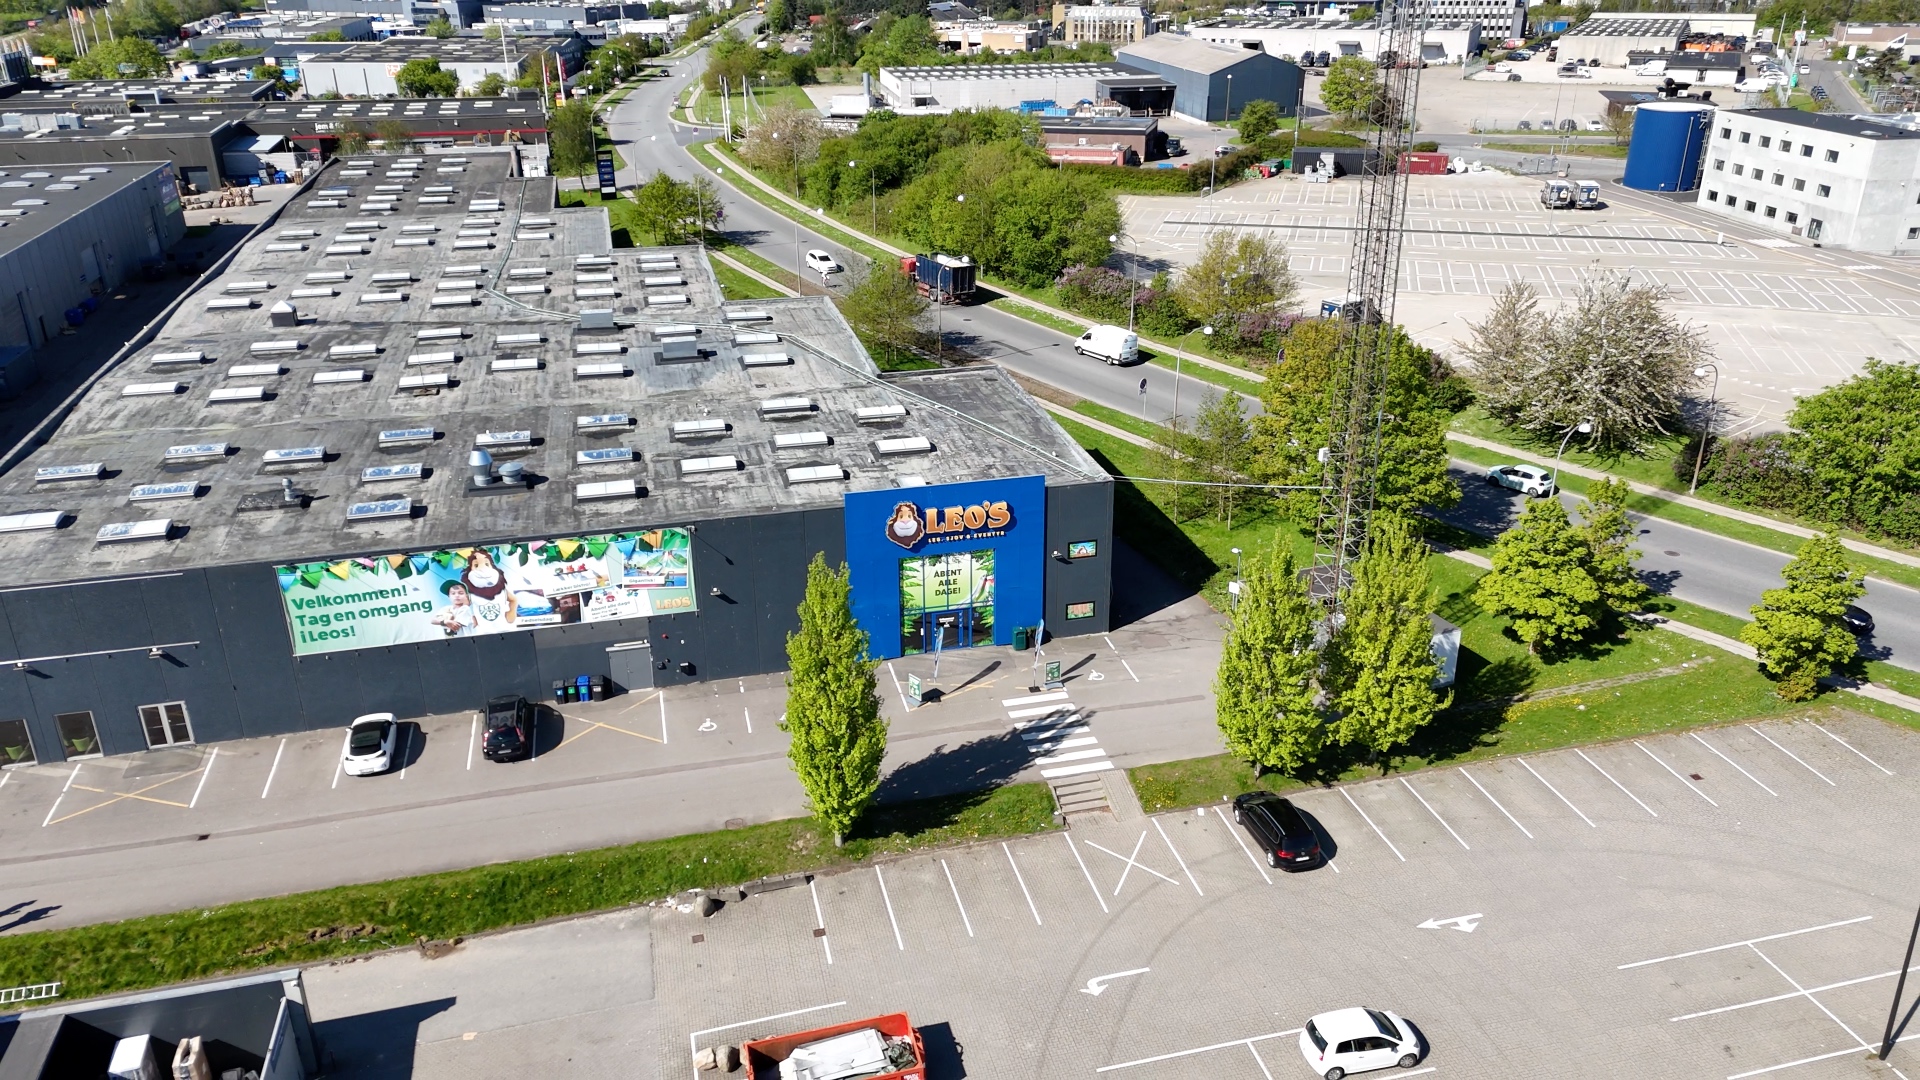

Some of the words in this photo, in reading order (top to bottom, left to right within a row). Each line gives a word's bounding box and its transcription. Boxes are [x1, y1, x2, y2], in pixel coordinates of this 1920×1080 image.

[925, 500, 1011, 533] LEO'S
[935, 587, 961, 596] DAGE!
[938, 578, 958, 587] ALLE
[291, 585, 408, 610] Velkommen!
[656, 596, 692, 610] LEO'S
[295, 614, 331, 627] Tag
[333, 610, 356, 622] en
[358, 600, 433, 619] omgang
[300, 631, 307, 643] i
[308, 625, 356, 643] Leos!
